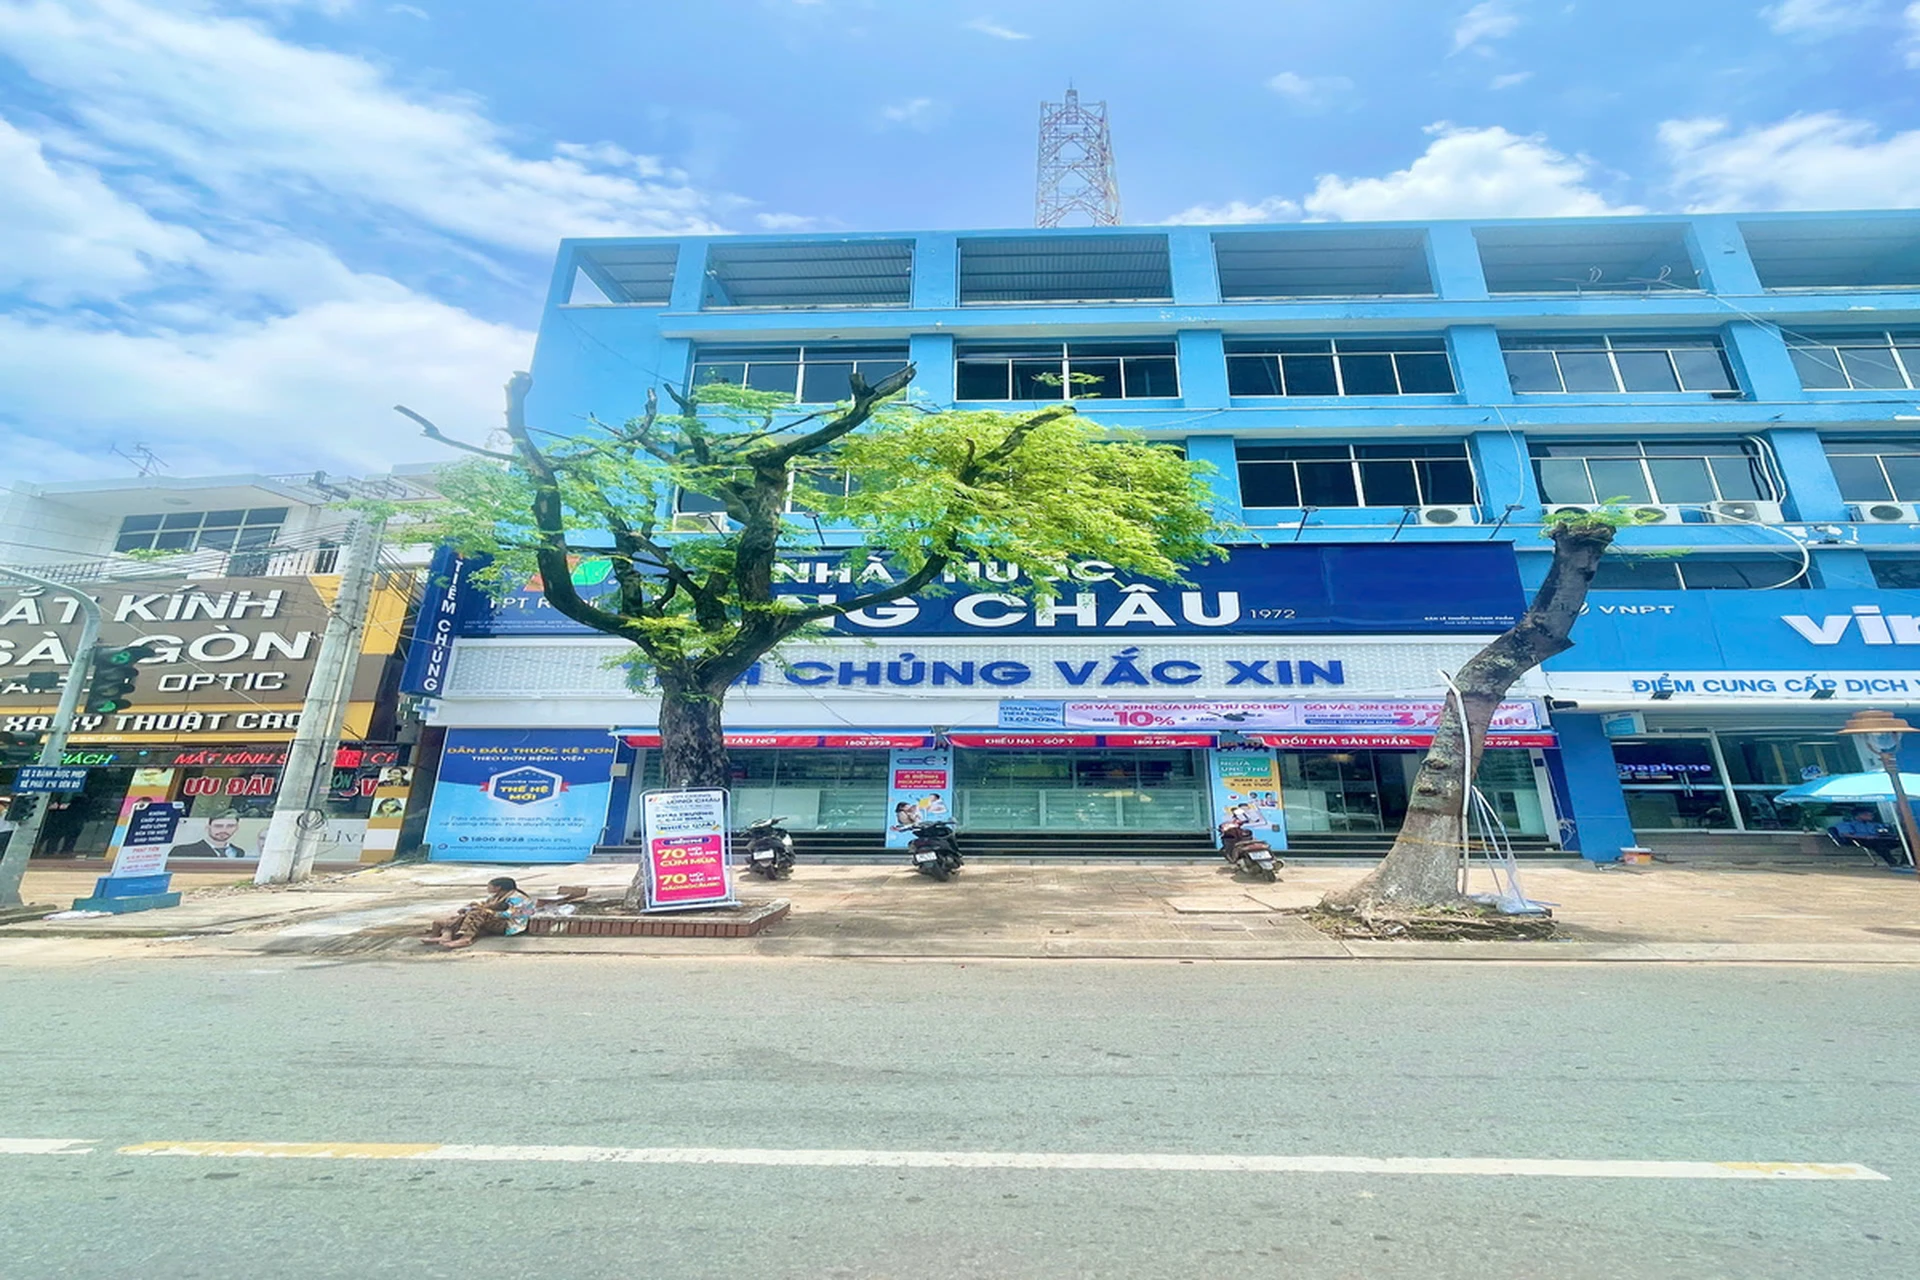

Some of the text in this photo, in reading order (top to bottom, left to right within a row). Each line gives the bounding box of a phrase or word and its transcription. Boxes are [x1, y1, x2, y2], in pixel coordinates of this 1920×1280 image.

[441, 560, 463, 615] TIÊM
[113, 584, 285, 622] KÍNH
[953, 583, 1241, 627] CHÂU
[1250, 608, 1297, 619] 1972
[1599, 605, 1675, 615] VNPT
[785, 652, 1031, 686] CHỦNG
[1055, 646, 1203, 686] VẮC
[1226, 660, 1345, 685] XIN
[157, 671, 287, 692] OPTIC
[1632, 673, 1696, 693] ĐIỂM
[1702, 679, 1777, 692] CUNG
[1844, 679, 1910, 695] DỊCH
[113, 711, 229, 732] THUẬT
[1114, 711, 1175, 727] 10%
[183, 773, 276, 796] ƯU ĐÃI
[657, 848, 686, 859] 70
[659, 873, 688, 885] 70
